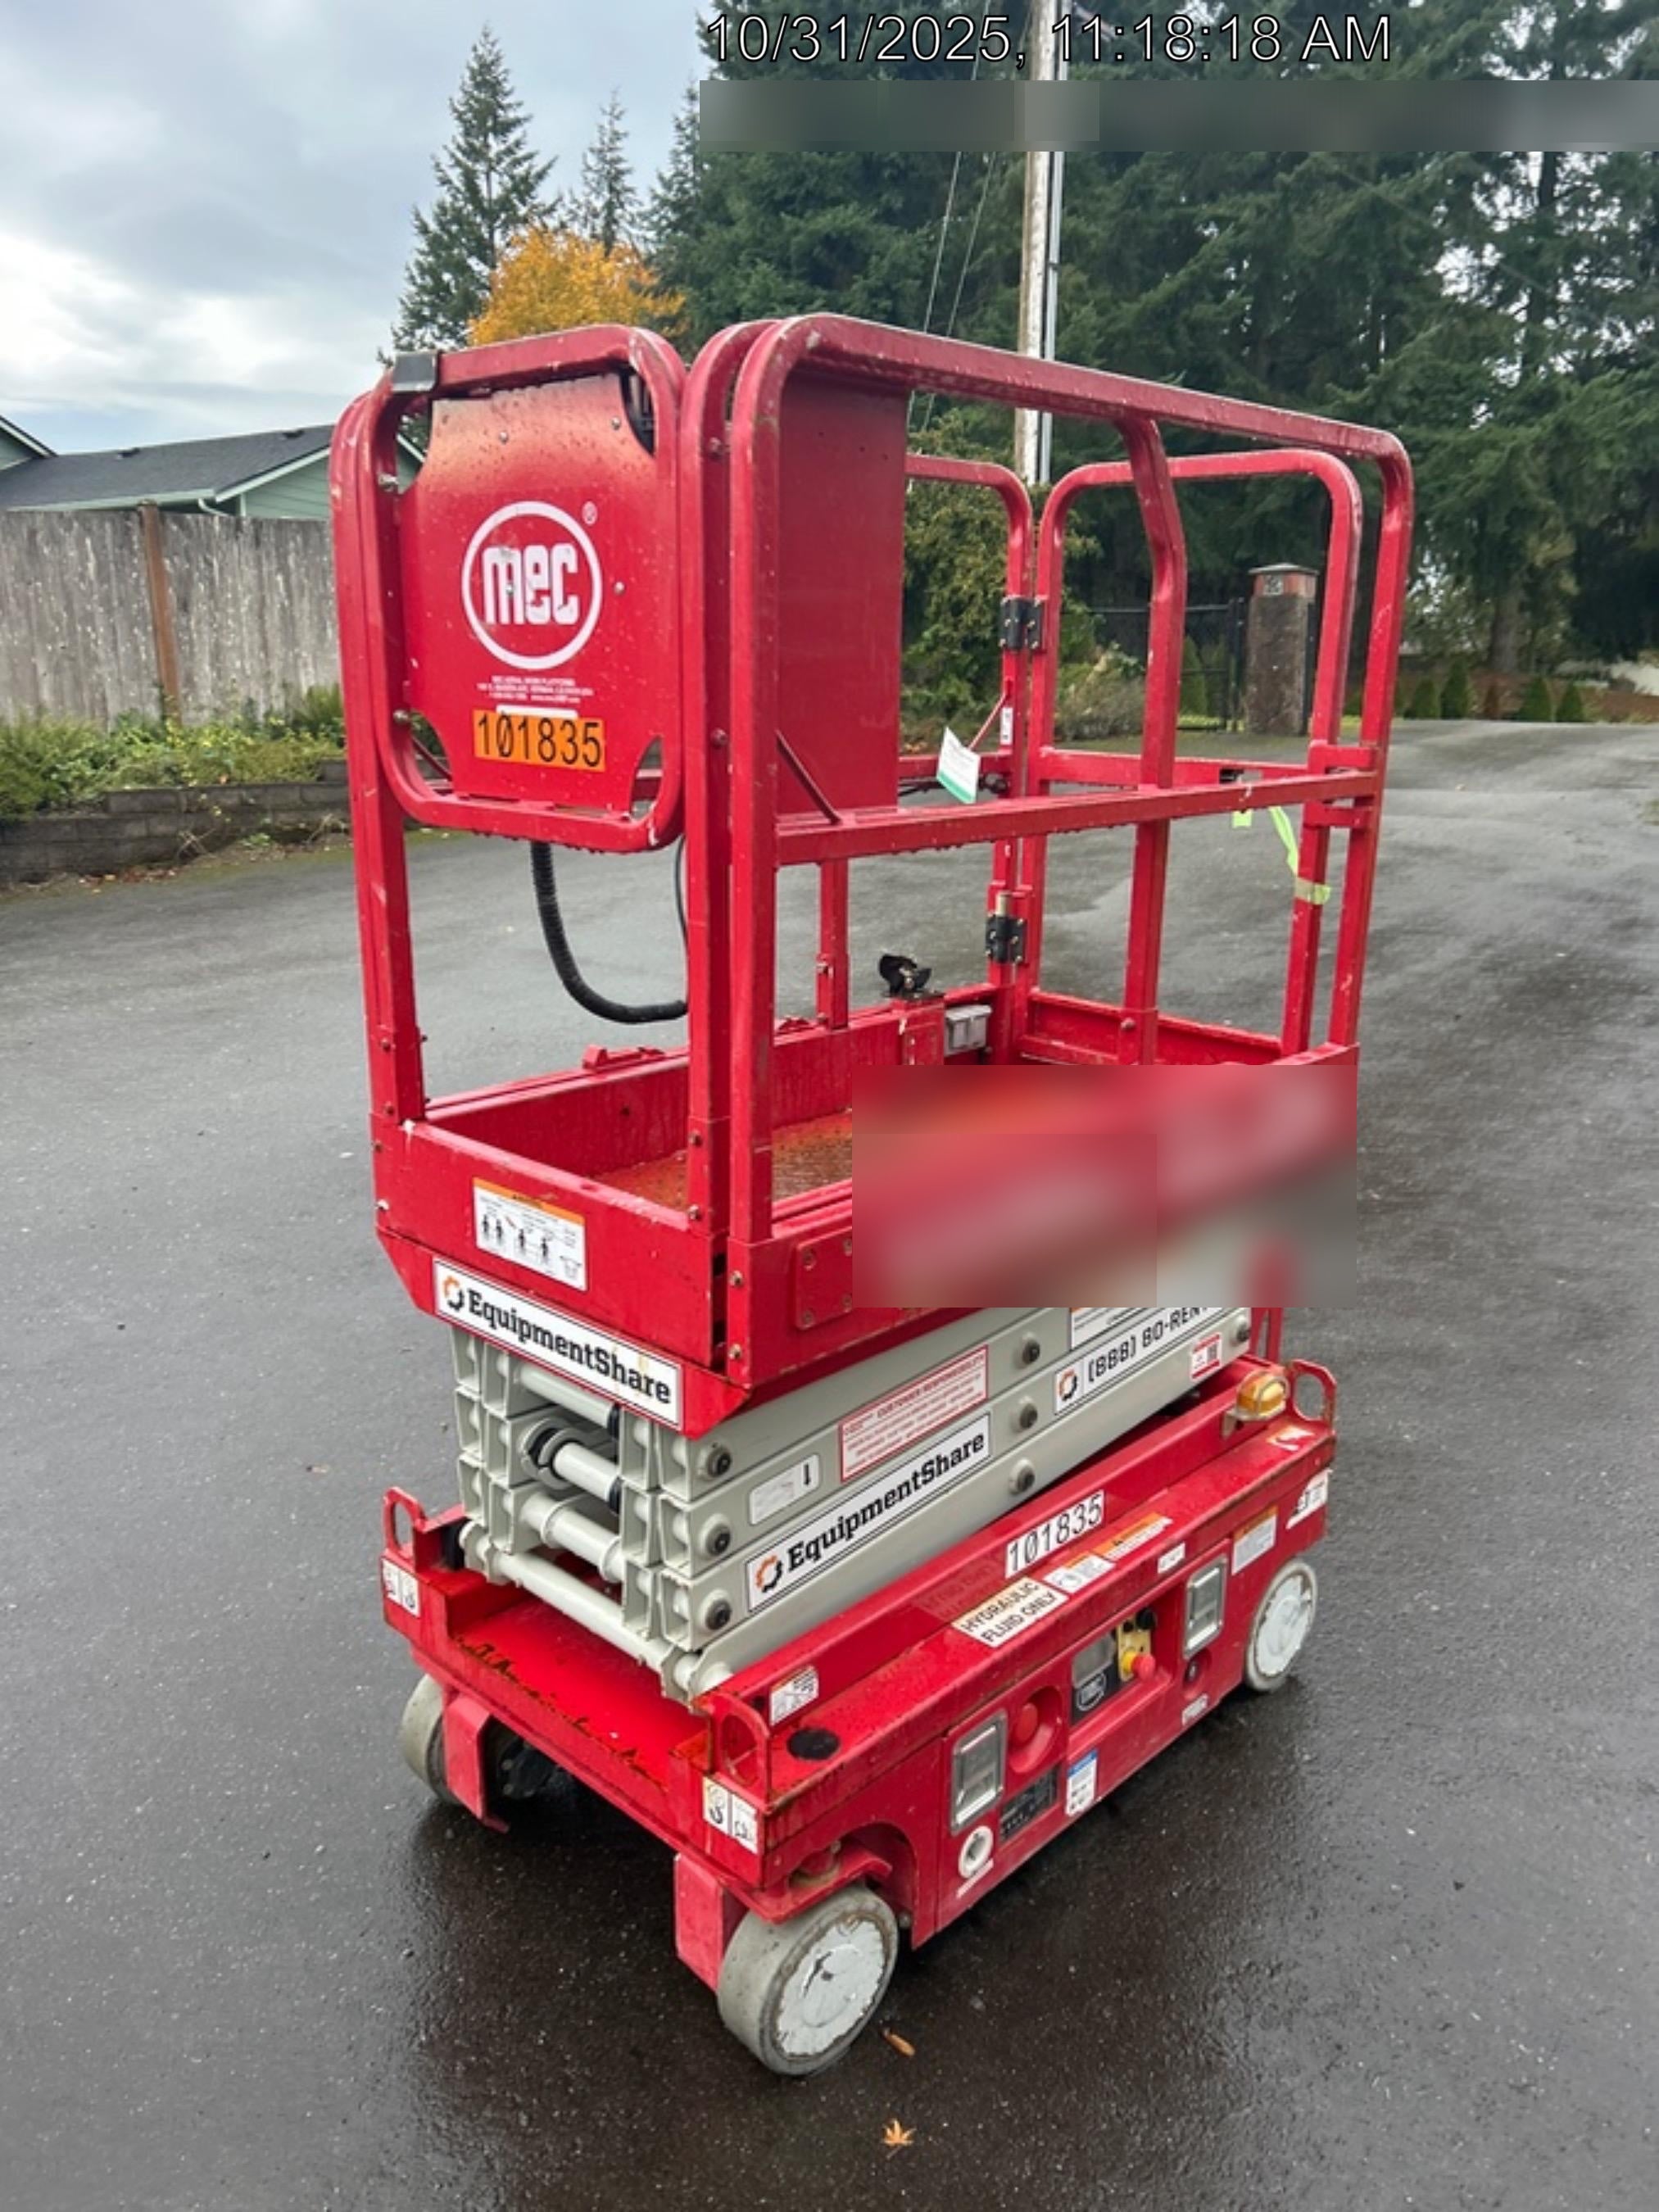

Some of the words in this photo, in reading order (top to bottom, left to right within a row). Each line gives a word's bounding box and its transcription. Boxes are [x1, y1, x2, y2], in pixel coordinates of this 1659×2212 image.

[478, 712, 601, 767] 101835
[468, 1289, 671, 1404] EquipmentShare
[787, 1433, 985, 1573] EquipmentShare
[1010, 1494, 1102, 1571] 101835
[961, 1581, 1040, 1632] HYDRAULIC
[981, 1615, 1024, 1643] FLUID
[1021, 1593, 1058, 1620] ONLY
